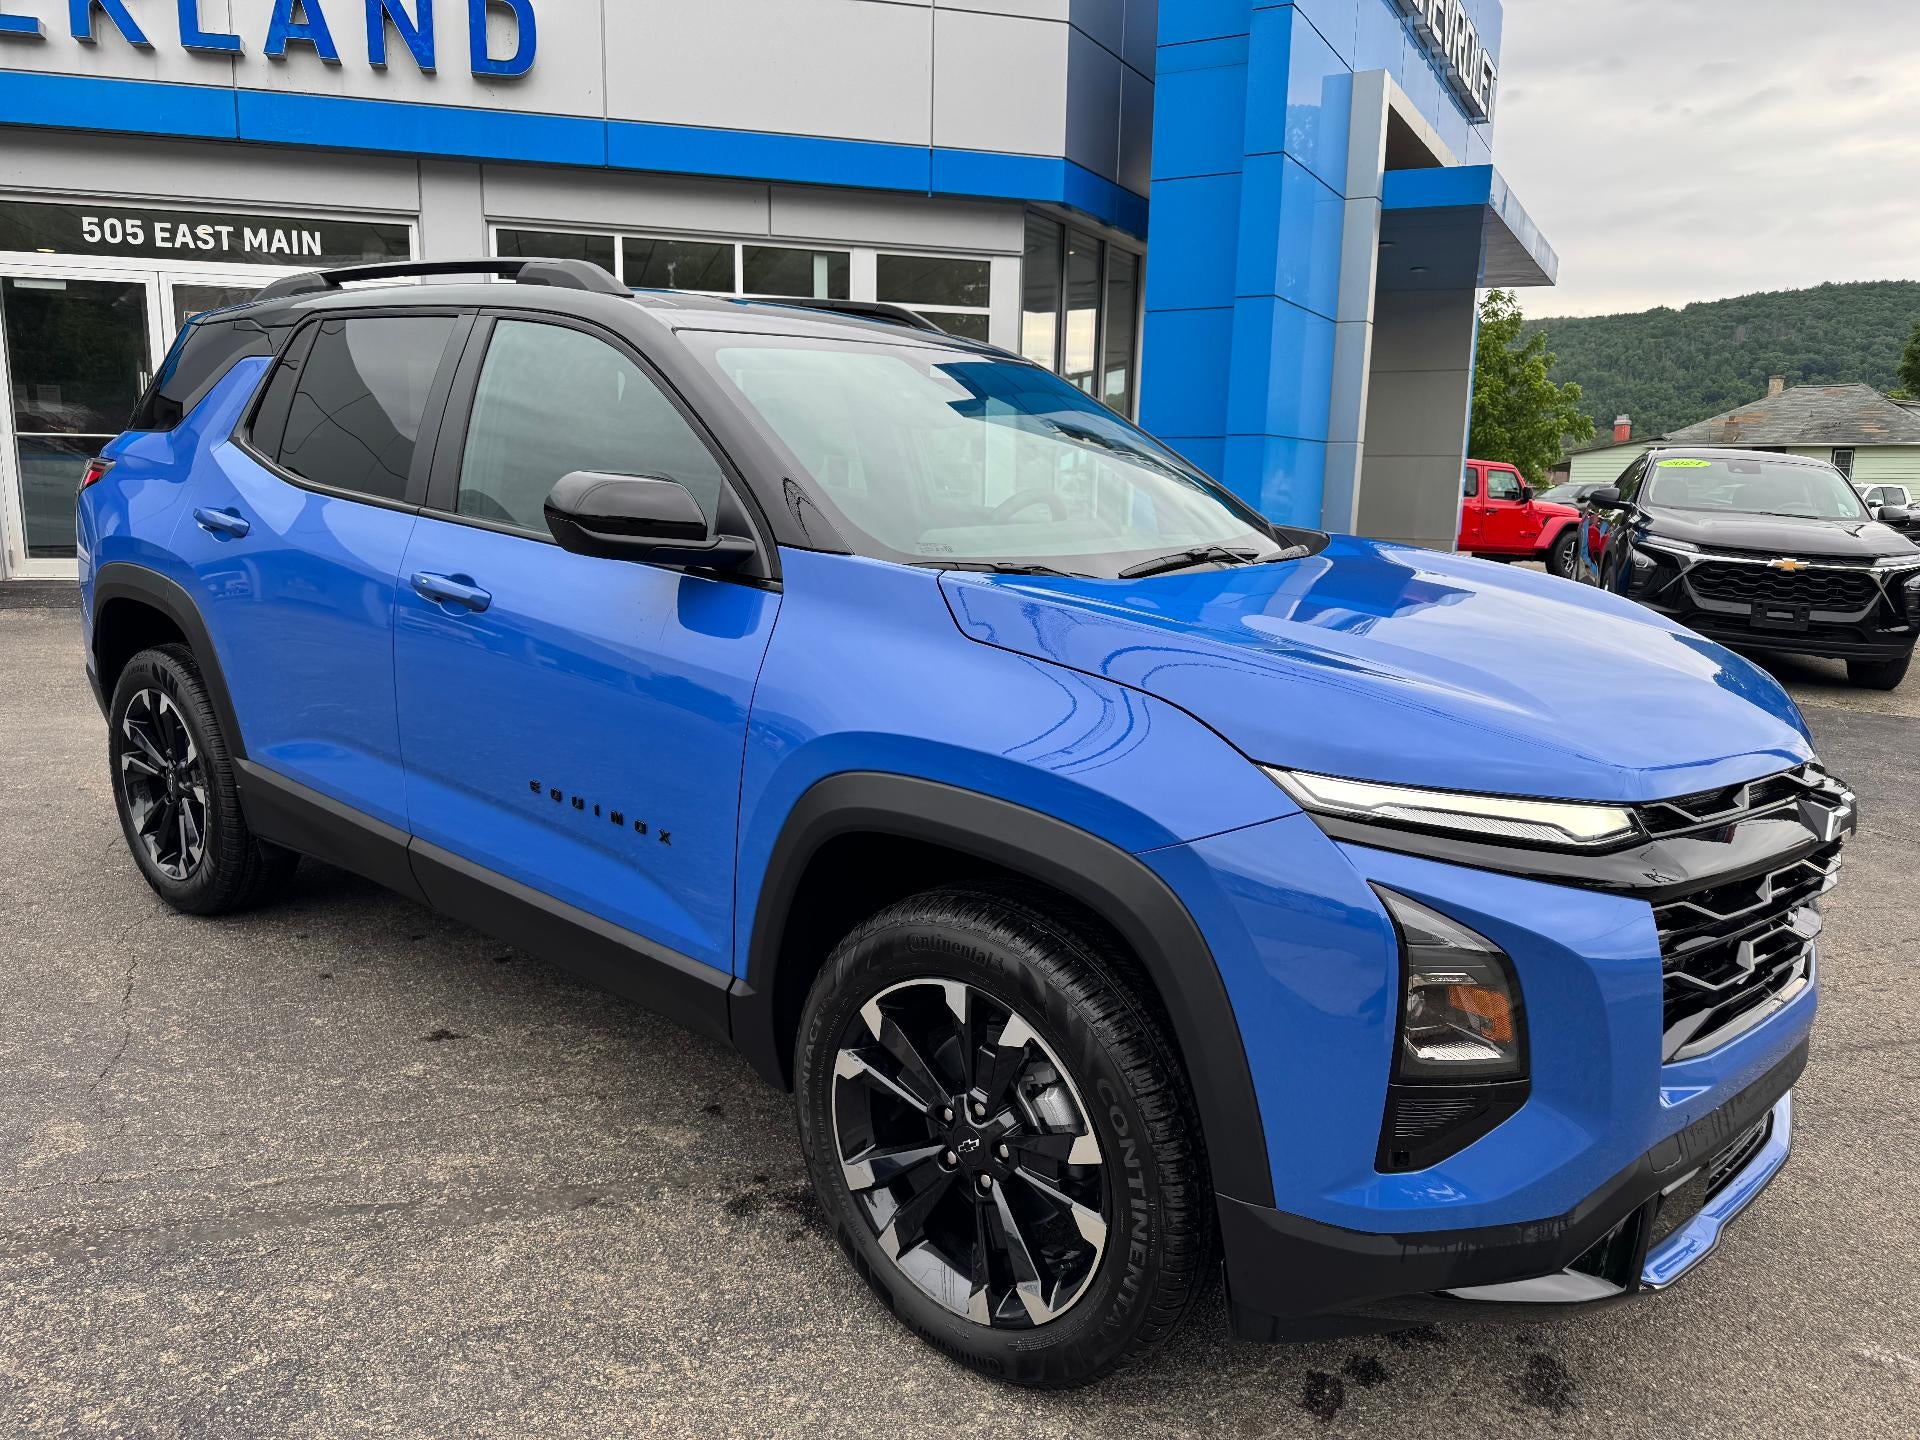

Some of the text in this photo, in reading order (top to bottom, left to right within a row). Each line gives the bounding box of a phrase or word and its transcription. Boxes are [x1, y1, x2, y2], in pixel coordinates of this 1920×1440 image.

[82, 216, 322, 255] 505 EAST MAIN
[529, 779, 672, 846] EQUINOX
[1097, 1079, 1148, 1325] CONTINENTA
